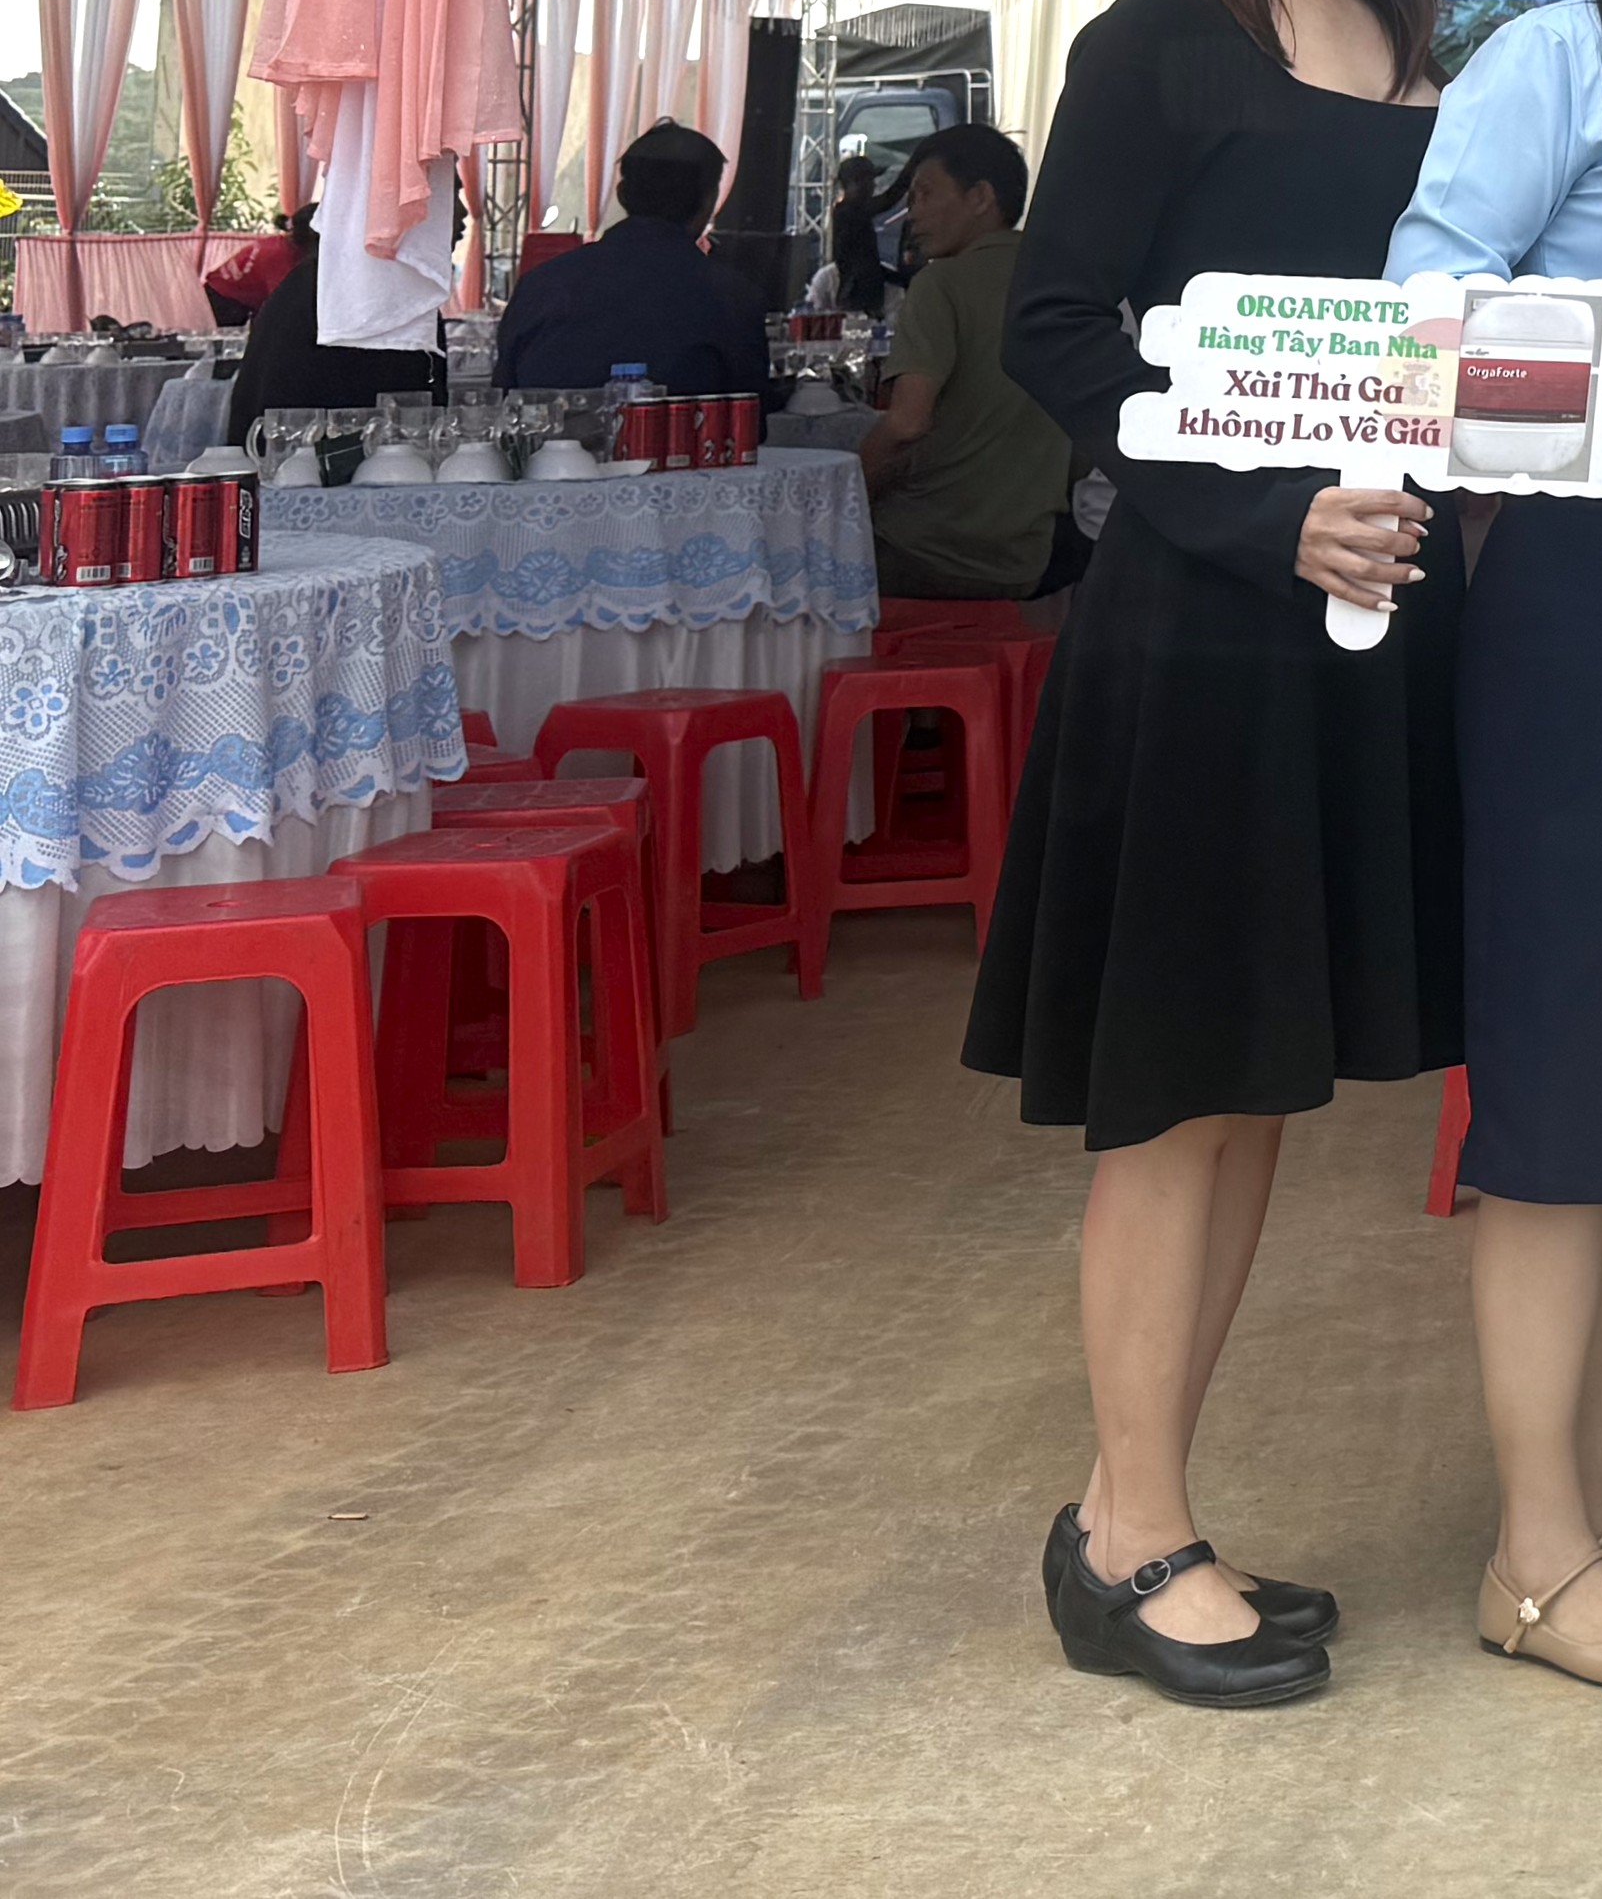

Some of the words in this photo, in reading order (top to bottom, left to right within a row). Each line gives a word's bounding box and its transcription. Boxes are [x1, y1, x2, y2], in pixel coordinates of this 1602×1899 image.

[1237, 295, 1409, 324] ORGAFORTE
[1199, 326, 1265, 356] Hàng
[1272, 330, 1321, 358] Tây
[1329, 334, 1379, 357] Ban
[1385, 335, 1437, 360] Nha
[1224, 370, 1280, 398] Xài
[1287, 372, 1352, 401] Thả
[1358, 377, 1404, 403] Ga
[1467, 365, 1528, 381] OrgaForte
[1178, 408, 1286, 446] không
[1292, 413, 1333, 442] Lo
[1339, 408, 1380, 443] Về
[1384, 416, 1441, 448] Giá
